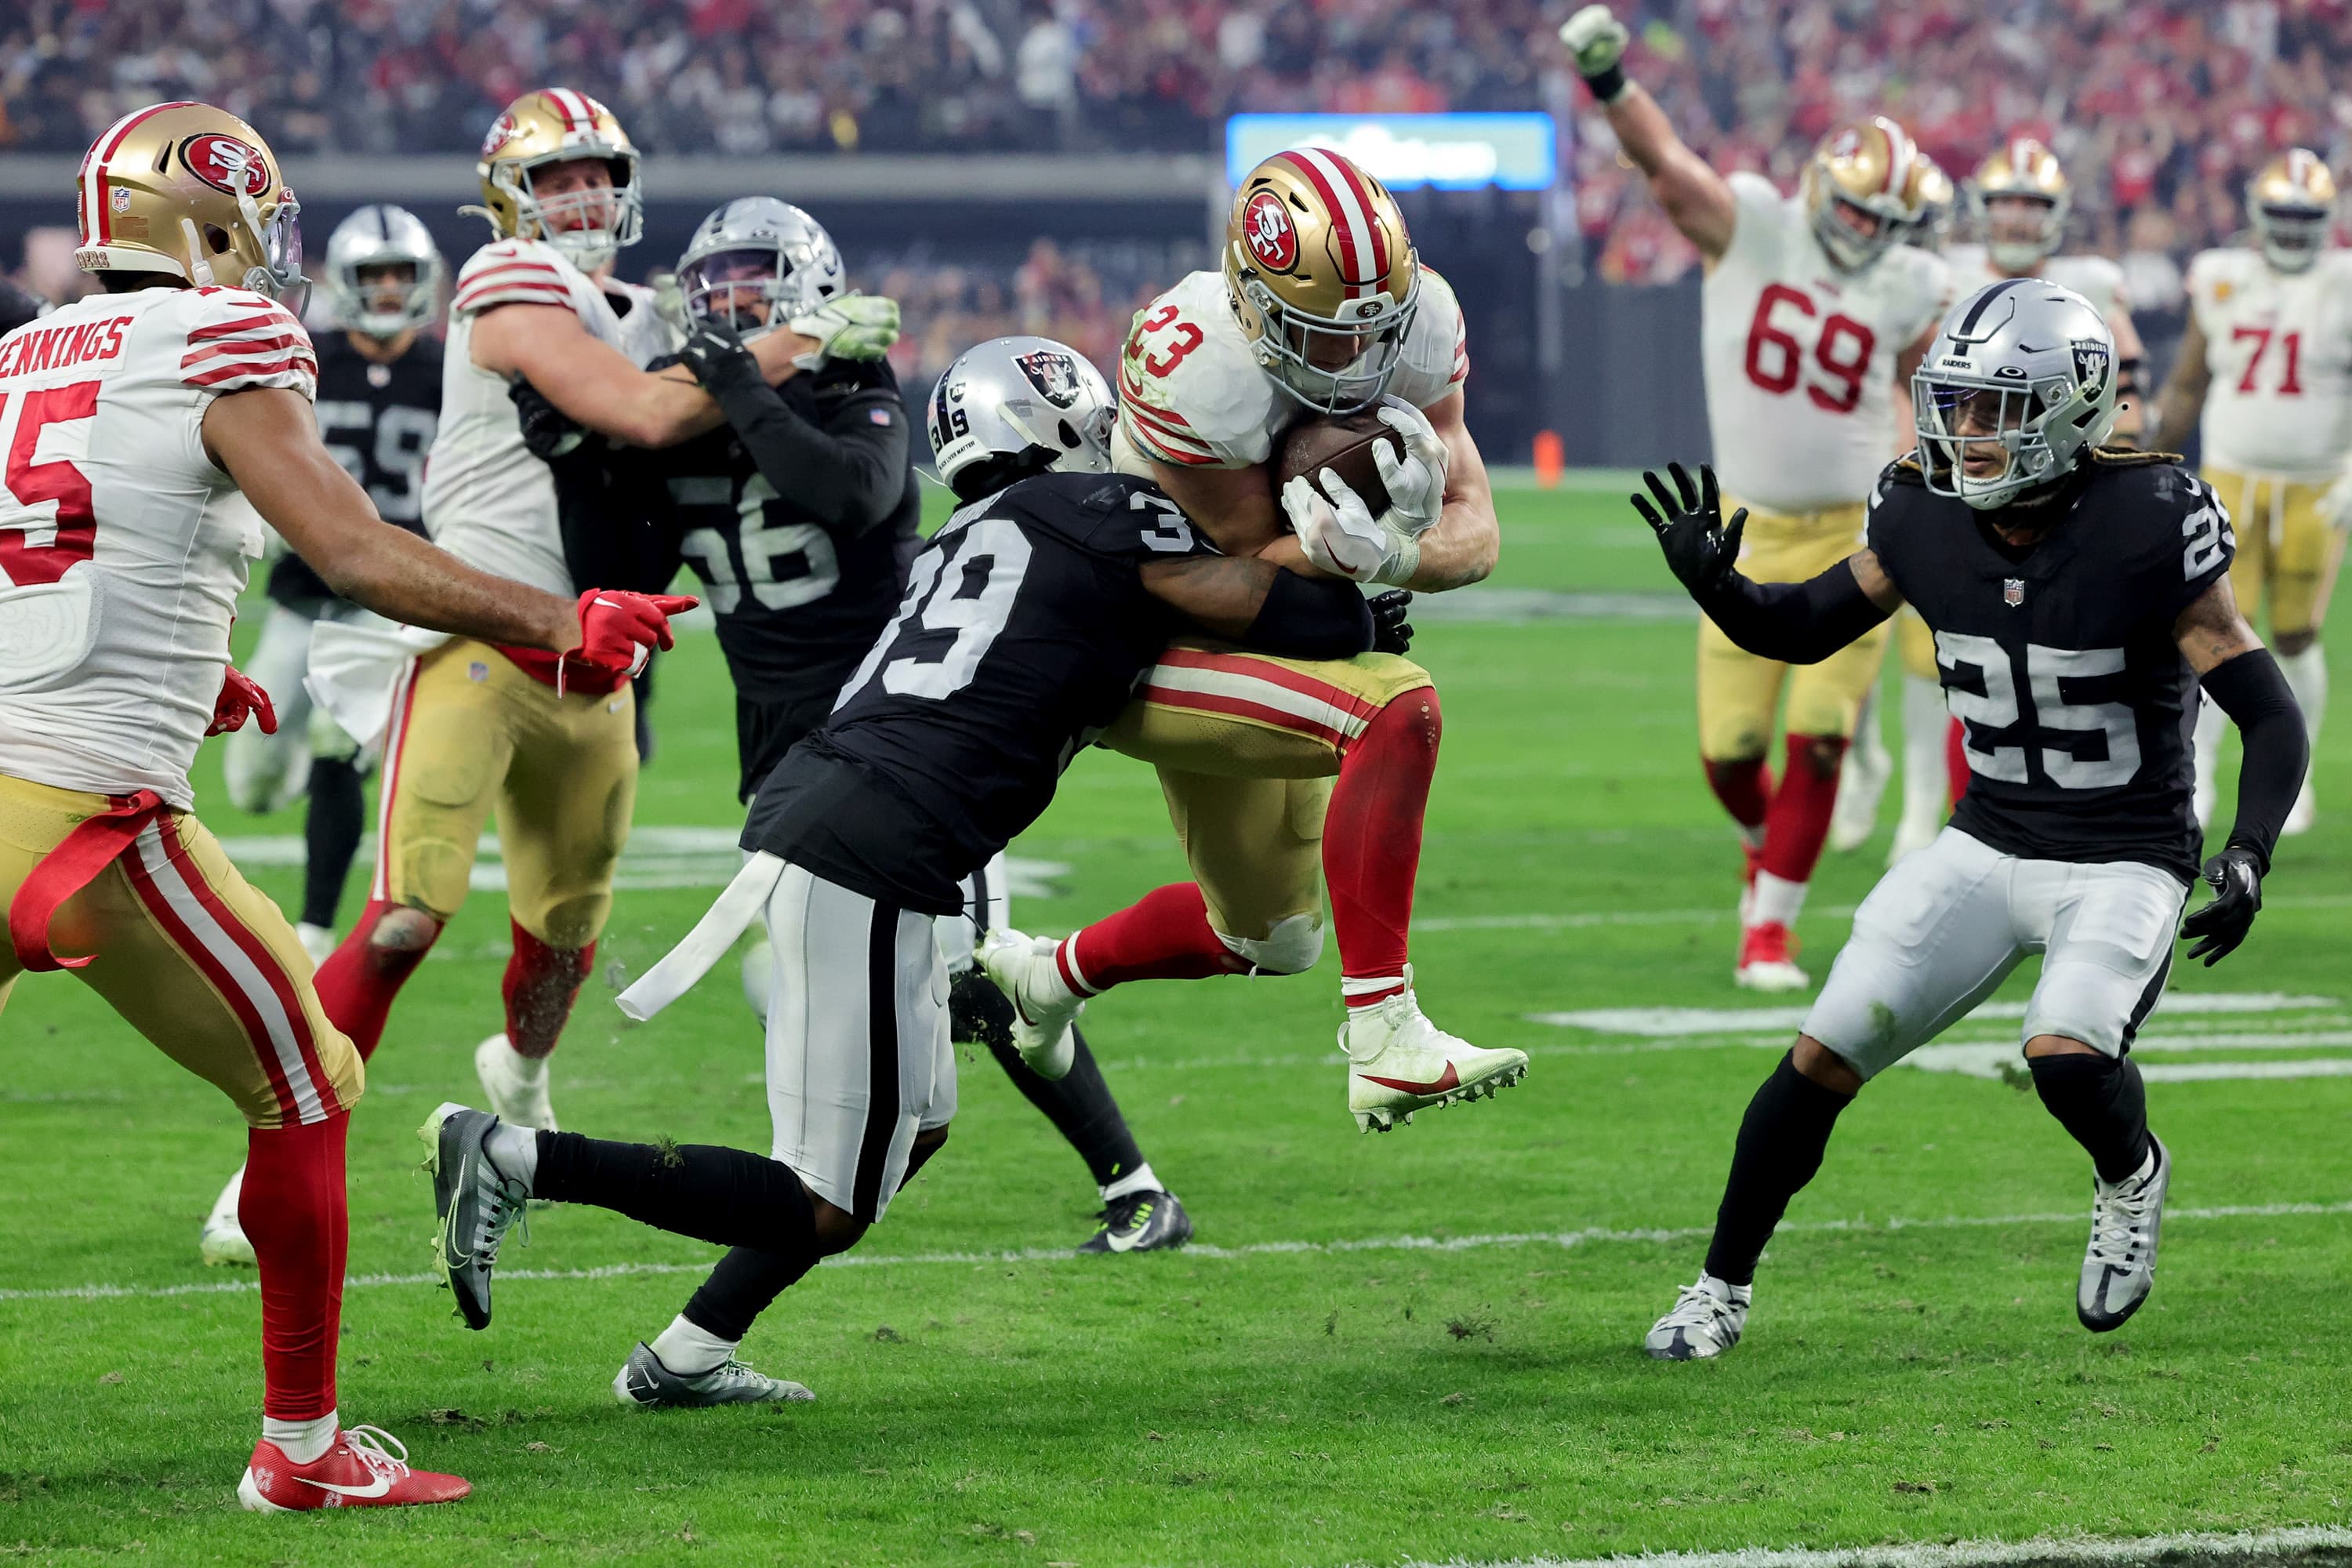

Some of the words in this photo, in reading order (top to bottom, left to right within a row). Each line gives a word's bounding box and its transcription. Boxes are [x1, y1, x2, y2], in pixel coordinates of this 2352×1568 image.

[0, 316, 134, 379] ENNINGS
[1022, 354, 1069, 365] RAIDERS
[1128, 305, 1203, 379] 23
[1744, 281, 1875, 415] 69
[1942, 358, 1971, 369] RAIDERS
[2074, 341, 2108, 353] RAIDERS
[2231, 327, 2302, 395] 71
[315, 400, 437, 522] 59
[931, 408, 970, 455] 39
[956, 440, 975, 455] MATTER
[0, 379, 102, 587] 5
[666, 472, 840, 614] 56
[830, 519, 1033, 716] 39
[1934, 629, 2142, 789] 25
